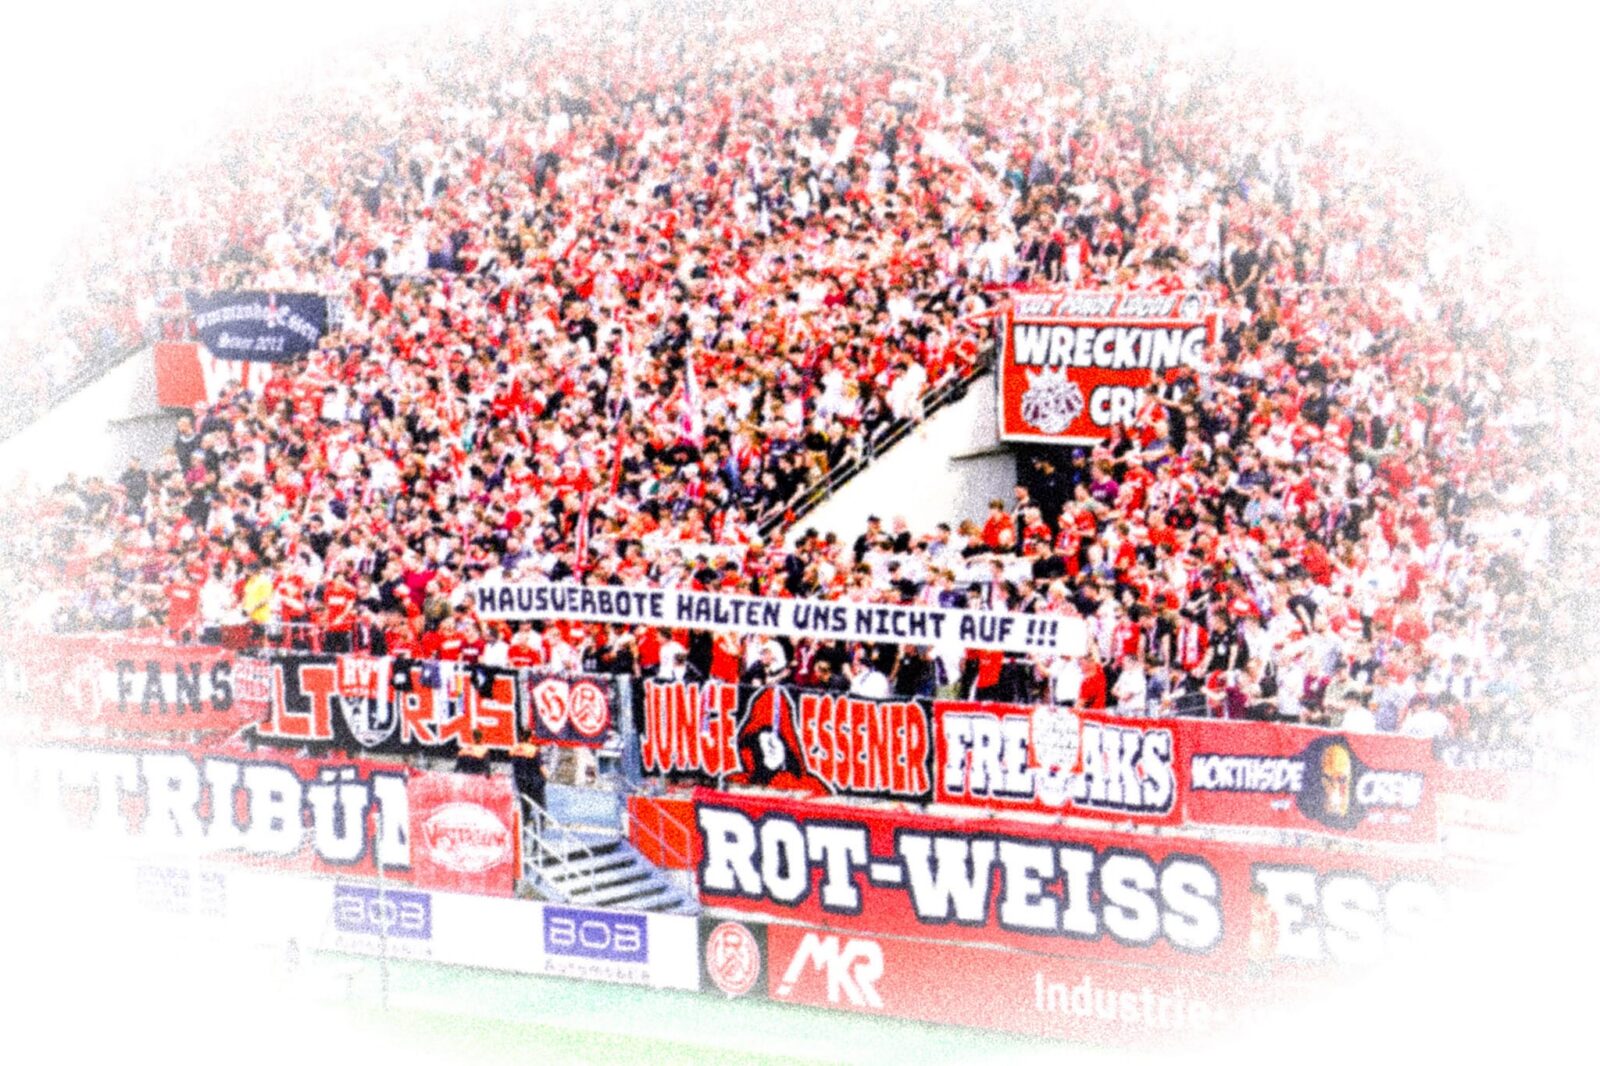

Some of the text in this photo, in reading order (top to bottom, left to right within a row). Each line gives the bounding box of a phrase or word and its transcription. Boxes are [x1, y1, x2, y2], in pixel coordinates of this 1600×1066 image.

[1013, 325, 1207, 368] WRECKING
[478, 586, 1059, 648] HAUSVERBOTE HALTEN UNS NICHT AUF !!!
[115, 659, 233, 716] FANS
[640, 678, 744, 779] JUNGE
[799, 694, 930, 796] ESSENER
[696, 805, 1224, 955] ROT-WEISS
[548, 916, 642, 953] BOB
